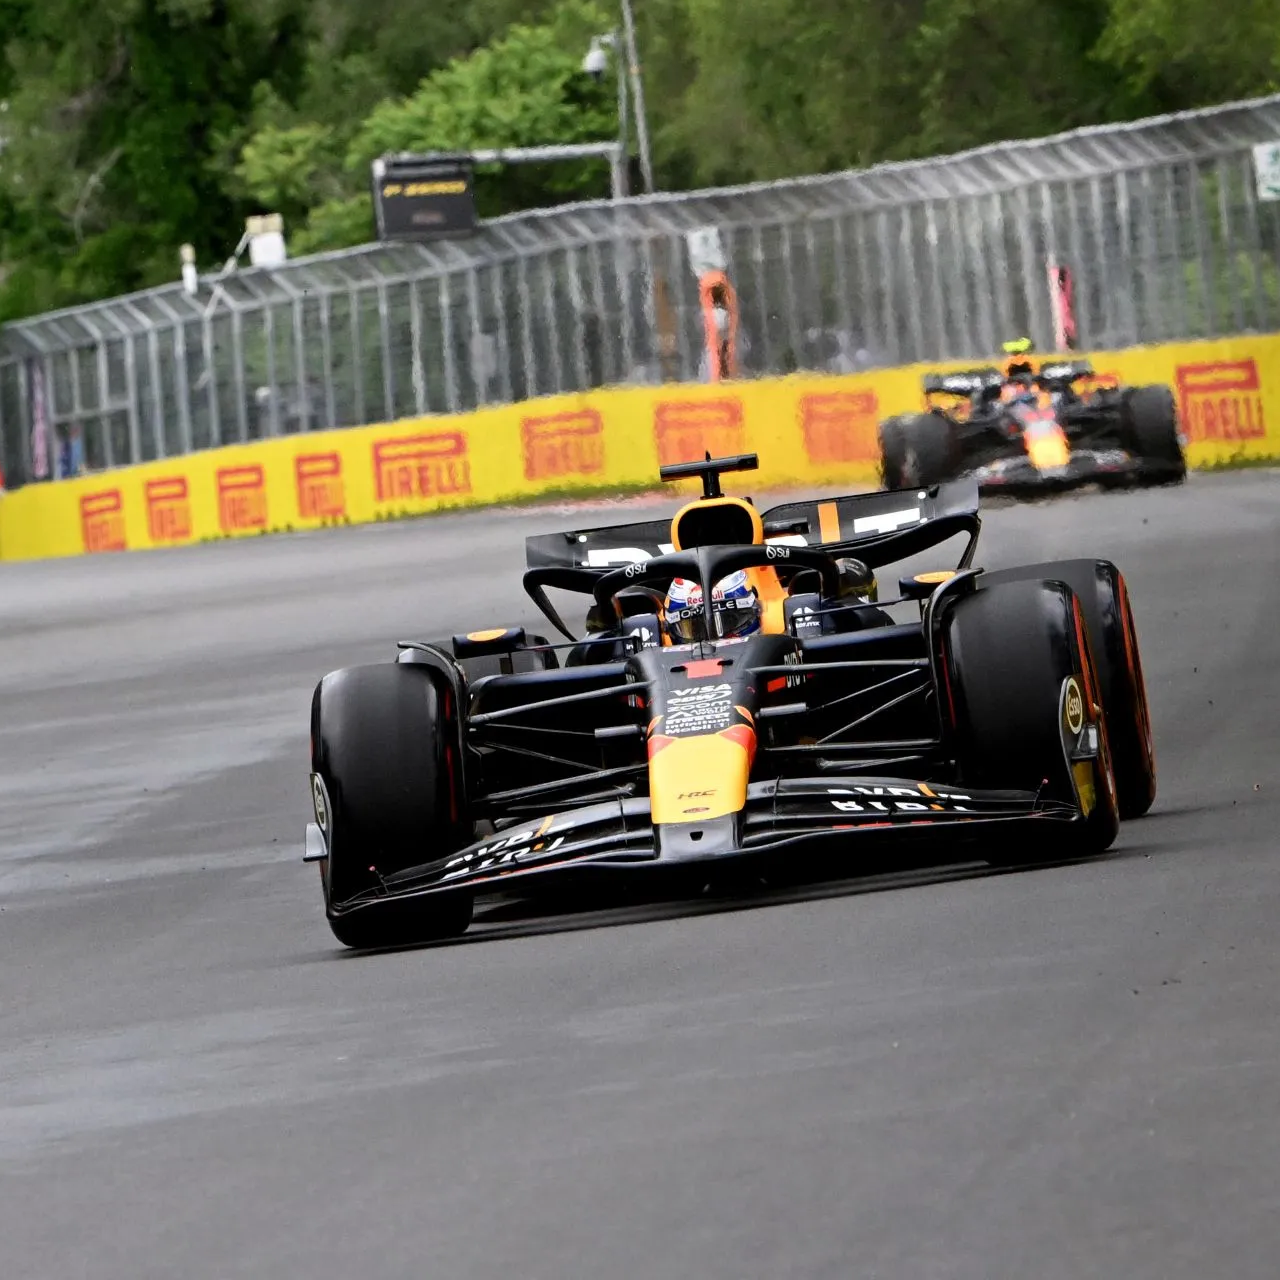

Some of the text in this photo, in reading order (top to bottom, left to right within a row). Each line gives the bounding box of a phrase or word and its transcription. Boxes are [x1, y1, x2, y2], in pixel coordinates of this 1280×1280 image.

[372, 431, 472, 502] PIRELLI
[670, 684, 732, 696] VISA
[668, 700, 731, 712] zoom
